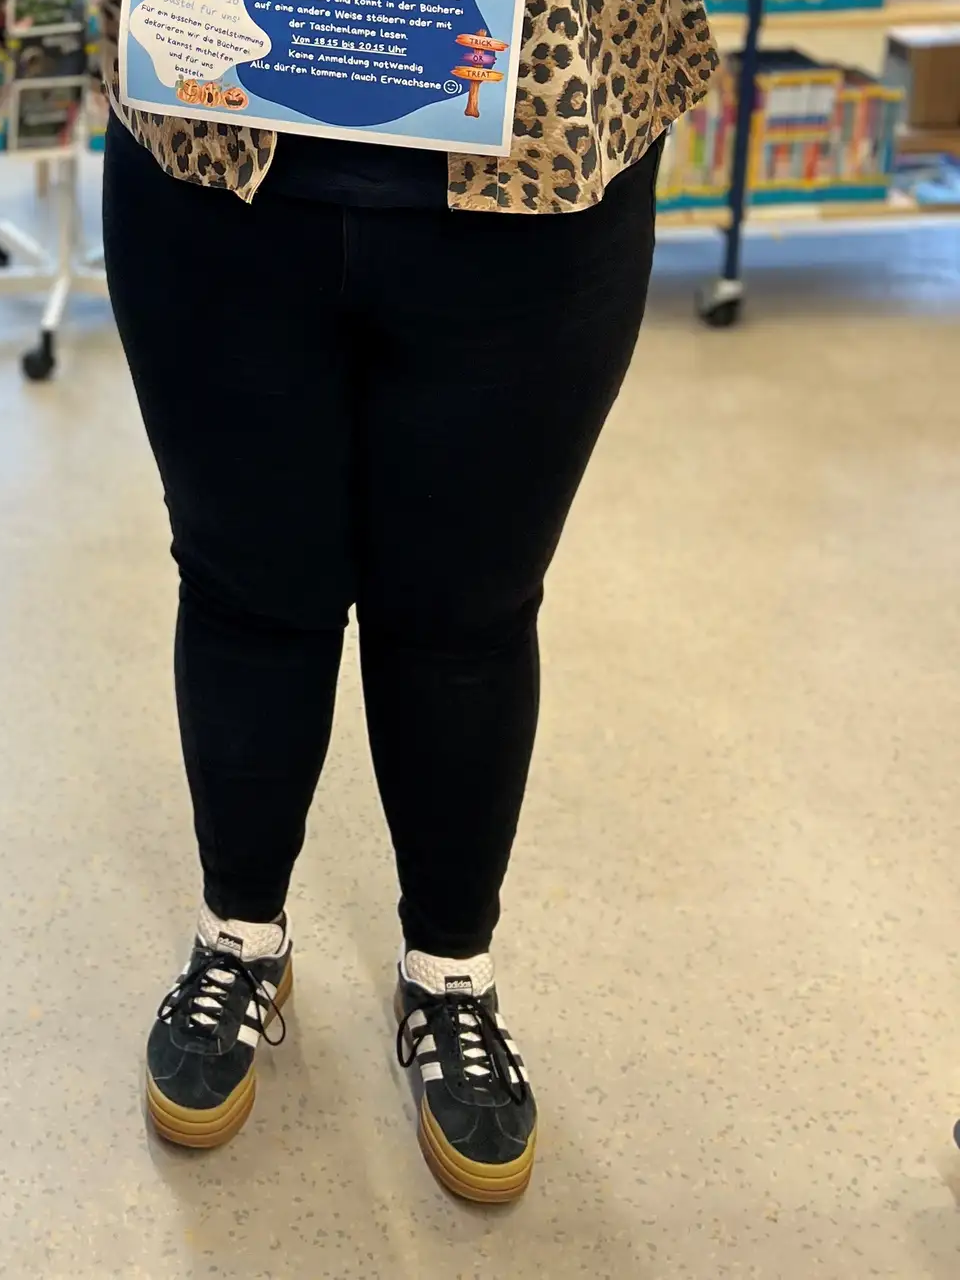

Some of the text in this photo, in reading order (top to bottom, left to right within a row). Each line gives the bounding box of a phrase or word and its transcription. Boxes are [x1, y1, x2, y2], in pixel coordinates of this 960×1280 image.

[254, 1, 452, 30] auf eine andere Weise stöbern oder mit
[398, 1, 416, 11] der
[419, 3, 464, 15] Bücherei
[288, 19, 377, 37] der Taschenlampe
[292, 34, 407, 54] Von bis Uhr
[469, 37, 492, 47] TRICK
[288, 49, 314, 60] Keine
[317, 54, 370, 68] Anmeldung
[250, 60, 271, 70] Alle
[273, 62, 308, 74] dürfen
[310, 66, 348, 78] kommen
[467, 70, 492, 78] TREAT
[446, 980, 471, 989] adidas
